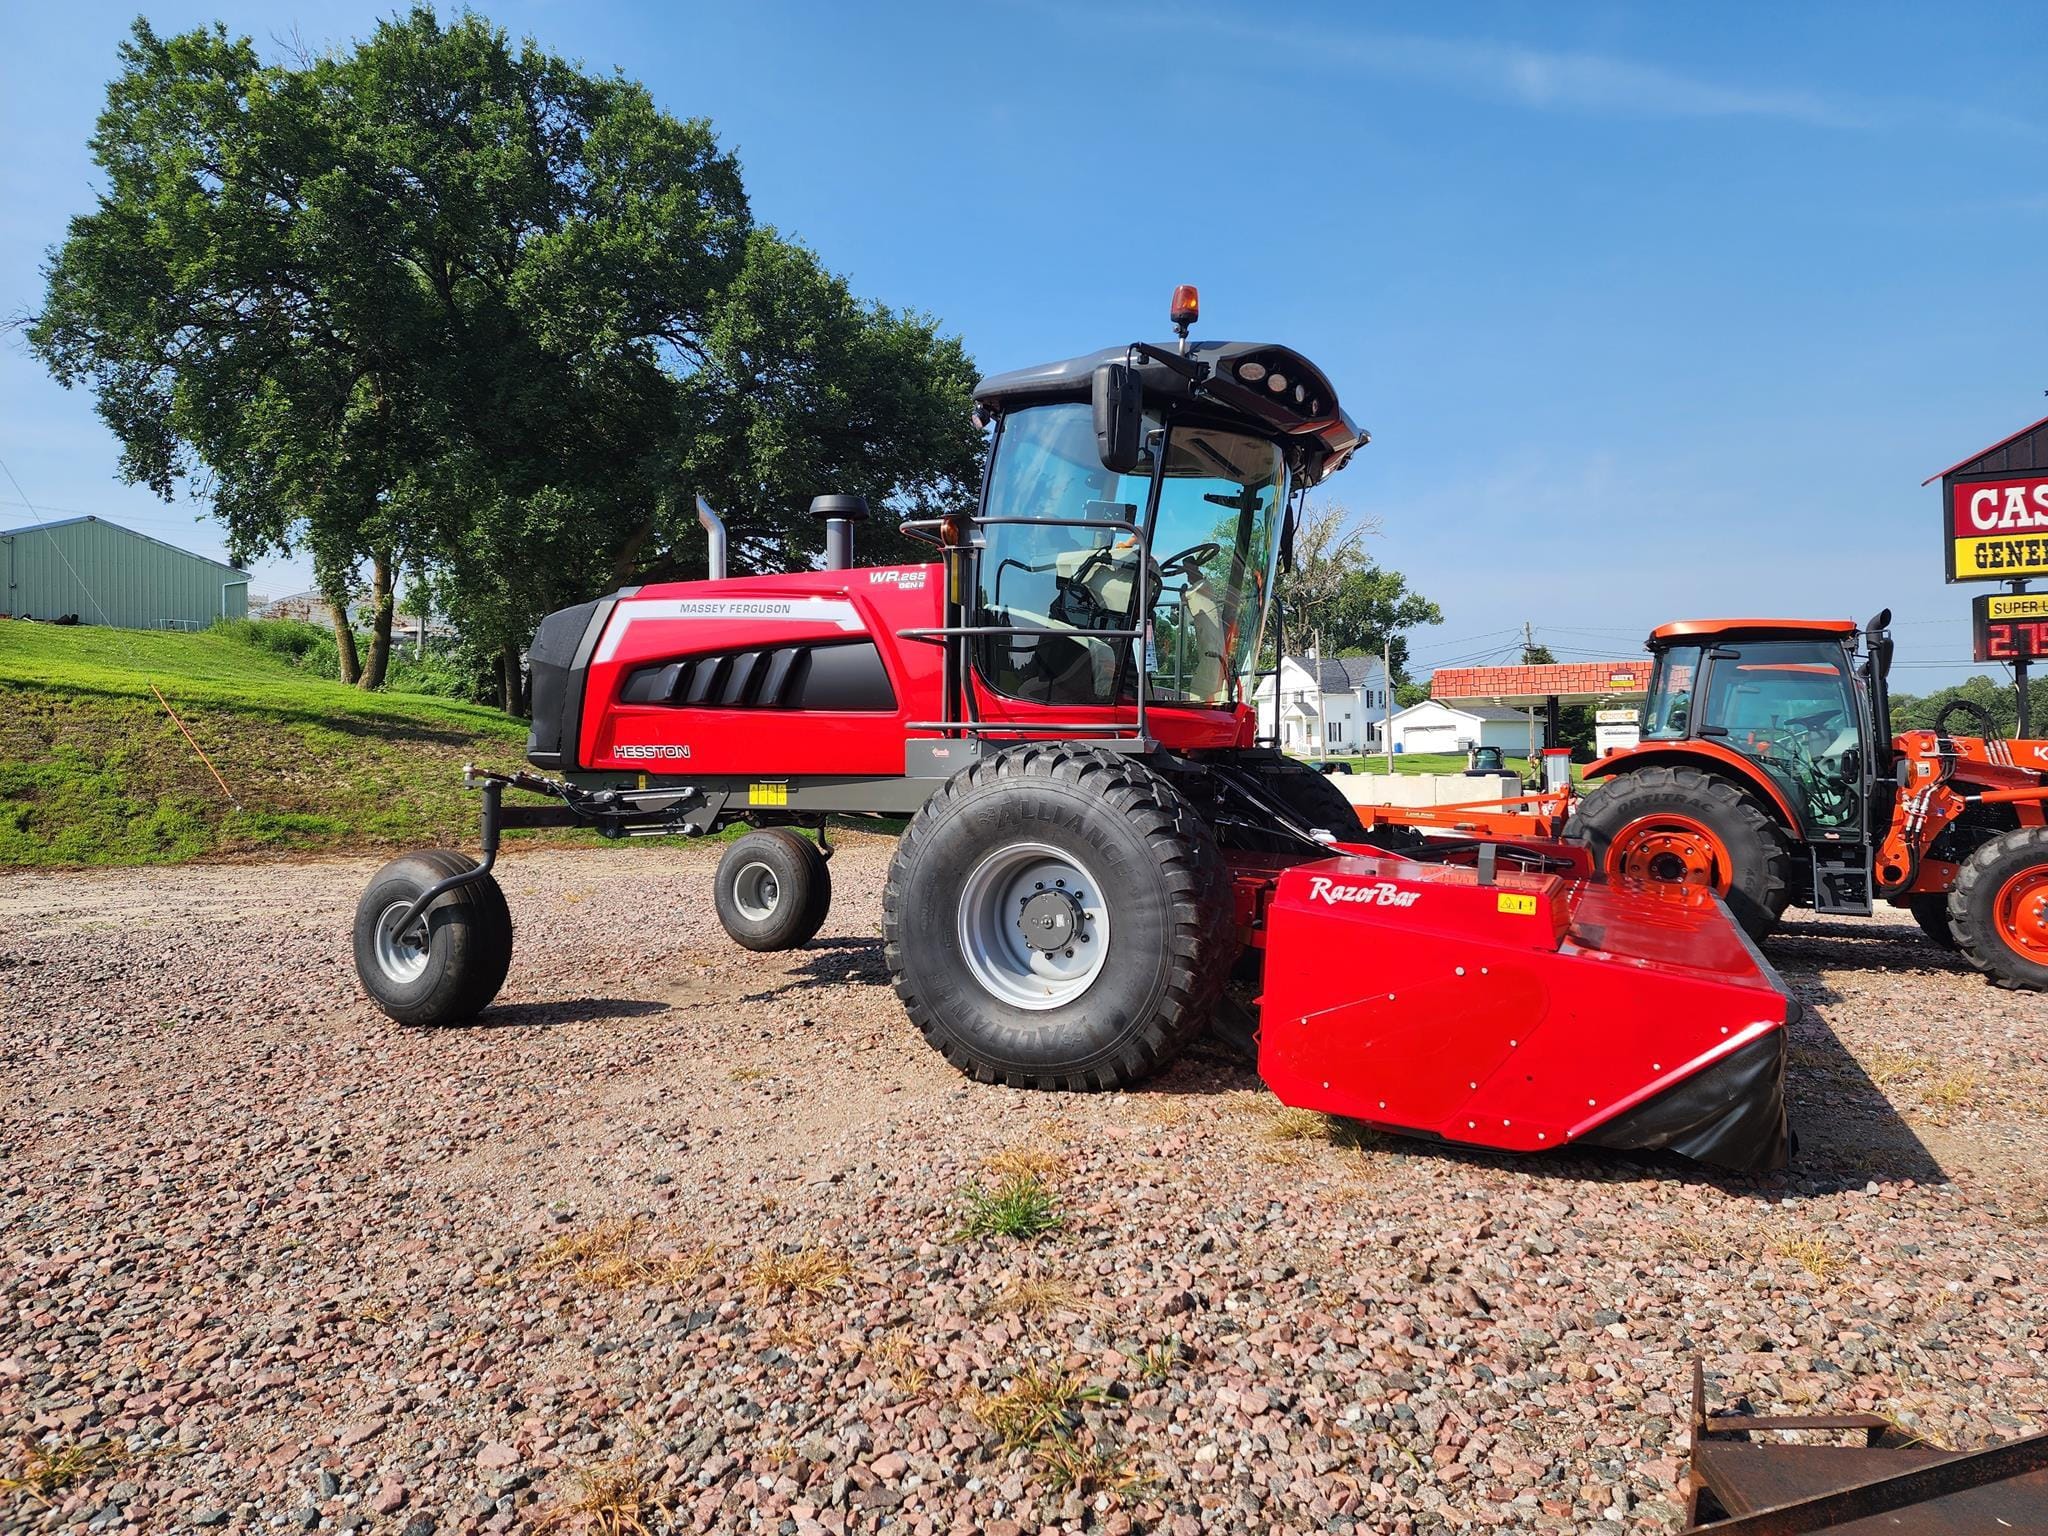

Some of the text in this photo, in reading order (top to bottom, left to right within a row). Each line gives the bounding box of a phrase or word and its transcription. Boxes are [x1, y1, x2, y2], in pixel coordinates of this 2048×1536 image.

[1971, 484, 2048, 530] CAS
[680, 604, 791, 614] MASSEY FERGUSON
[1994, 601, 2038, 615] SUPER
[613, 745, 691, 758] HESSTON
[1617, 793, 1715, 814] OPTITRAC
